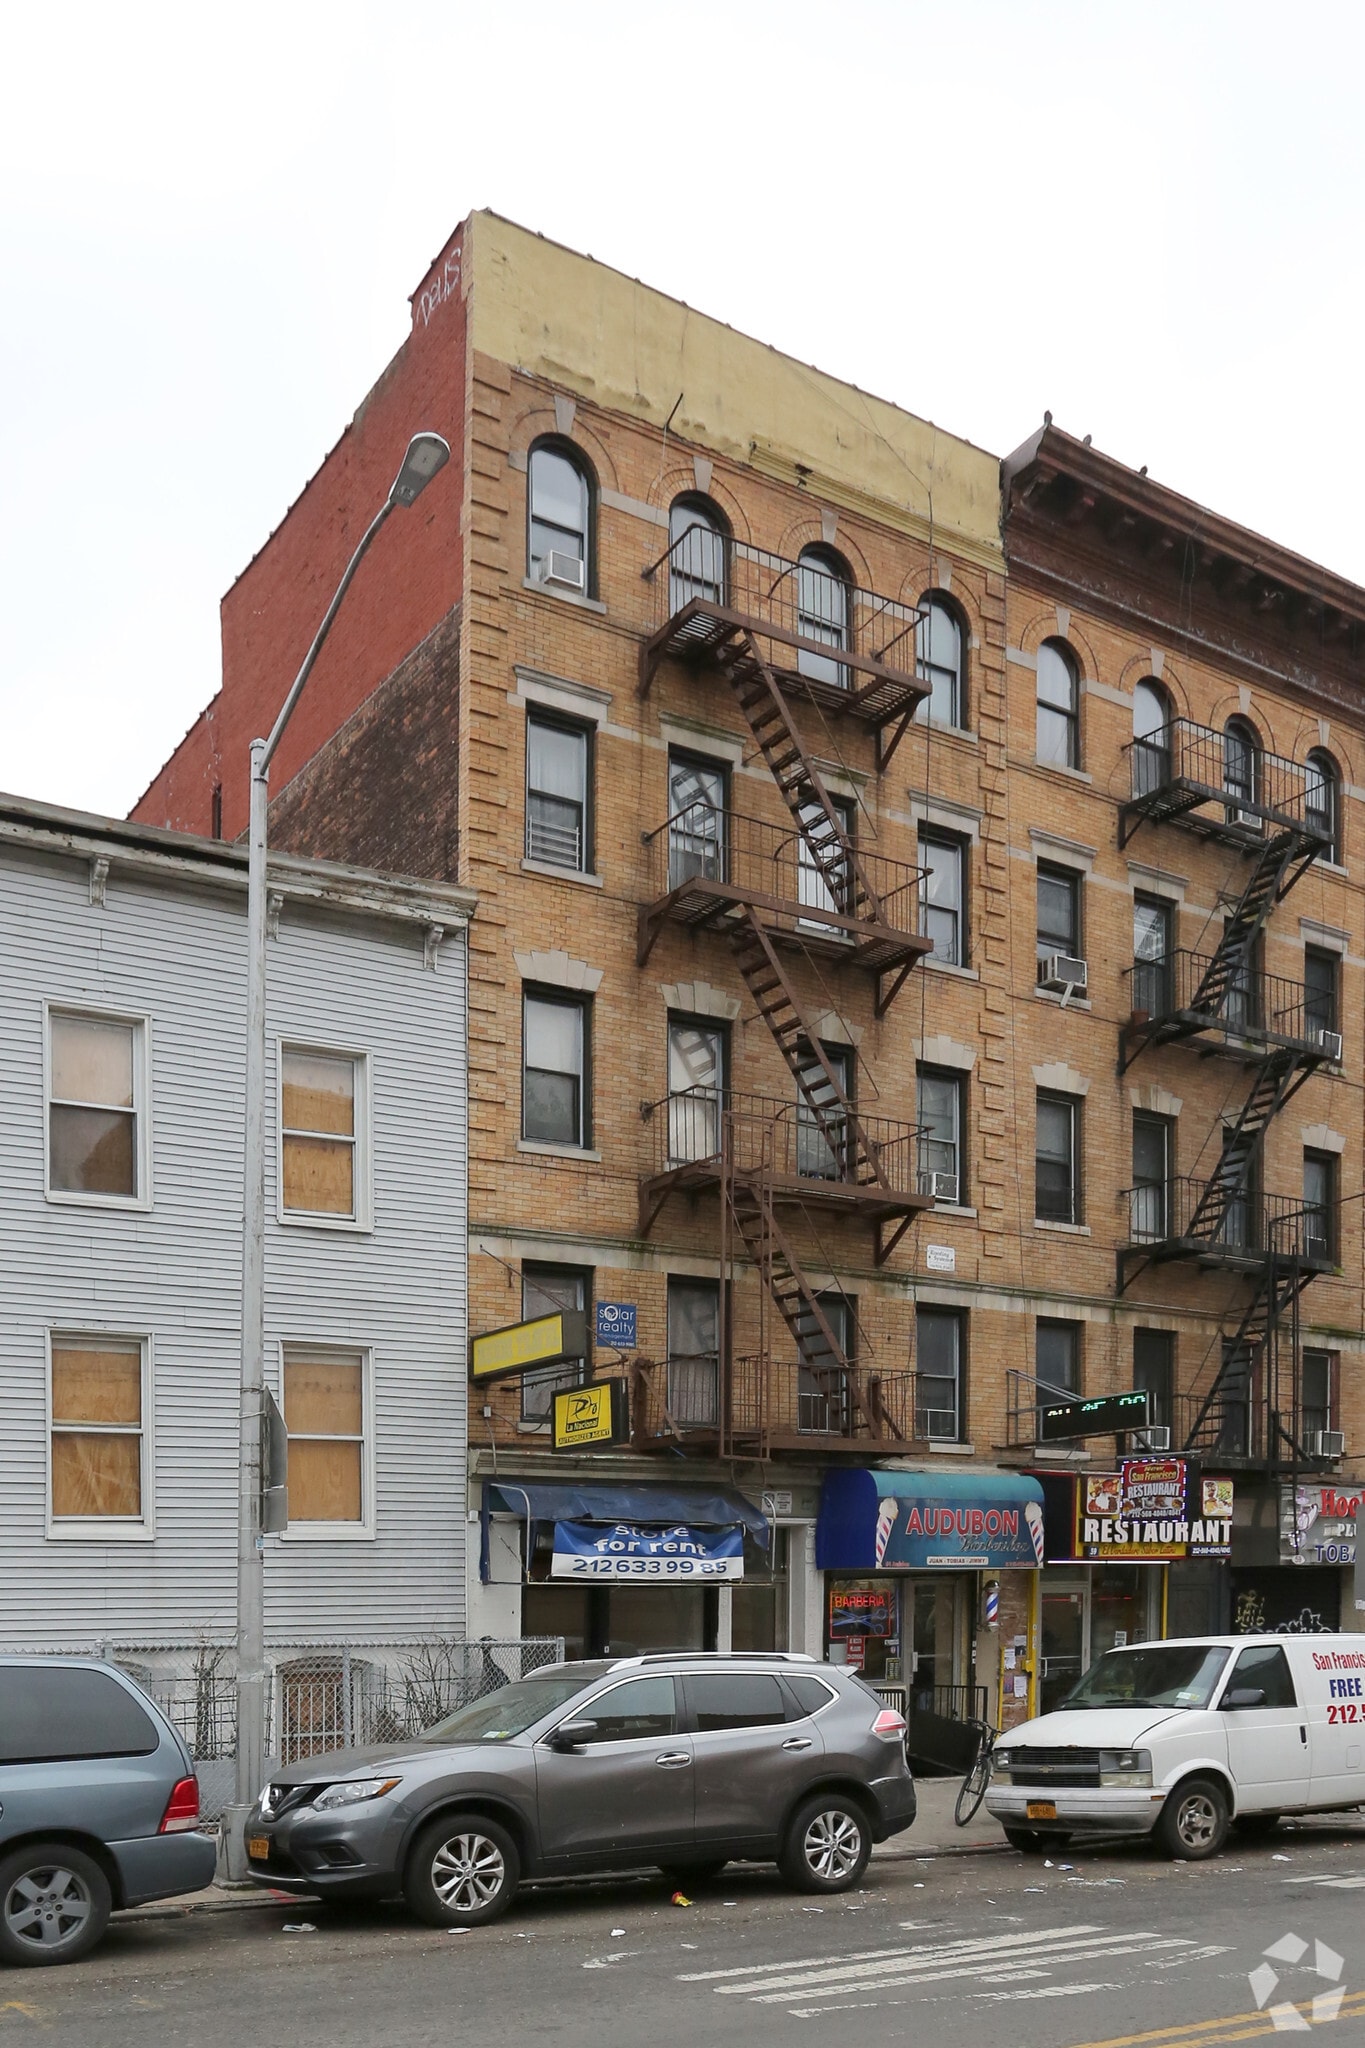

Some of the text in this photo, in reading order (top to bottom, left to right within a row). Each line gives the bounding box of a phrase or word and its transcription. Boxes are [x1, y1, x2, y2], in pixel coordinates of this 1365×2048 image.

[599, 1305, 634, 1321] solar
[599, 1322, 634, 1335] realty
[567, 1419, 598, 1431] La Nacional
[559, 1429, 610, 1444] AUTHORIZED AGENT
[1132, 1470, 1177, 1482] San Francisco
[1127, 1484, 1181, 1499] RESTAURANT
[905, 1507, 1019, 1536] AUDUBON
[1084, 1518, 1233, 1543] RESTAURANT
[594, 1539, 706, 1556] for rent
[834, 1595, 885, 1608] BARBERIA
[1312, 1652, 1333, 1671] San
[1329, 1677, 1363, 1699] FREE
